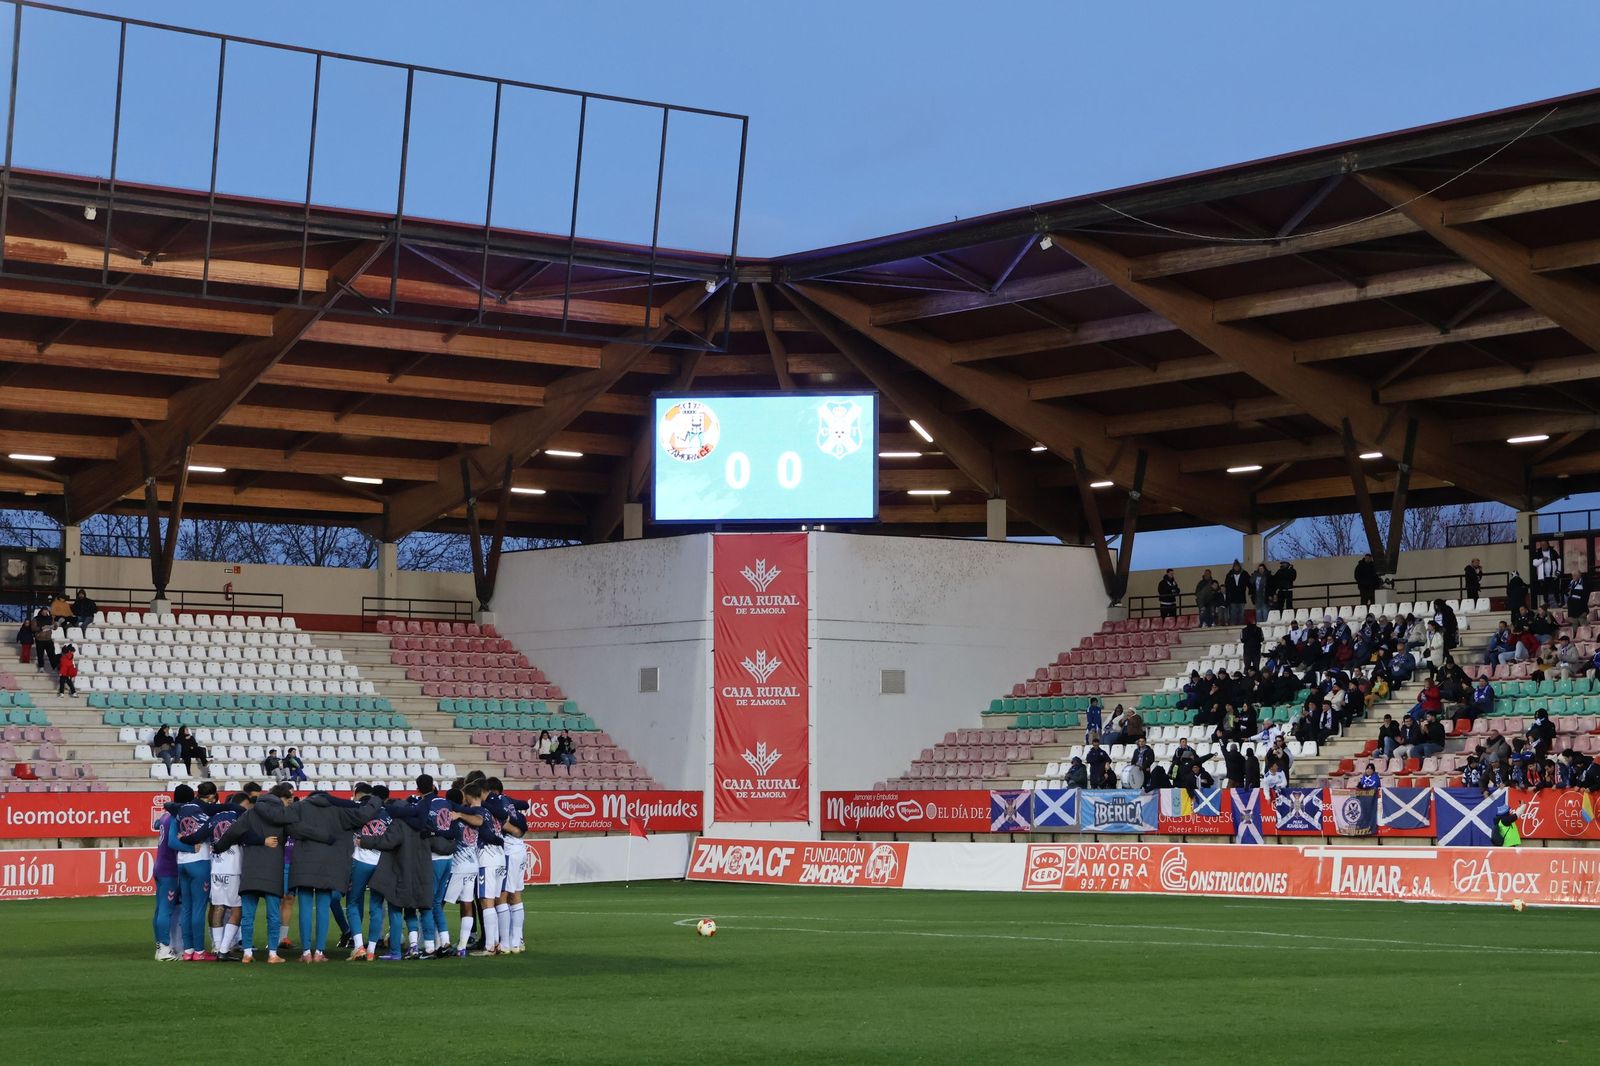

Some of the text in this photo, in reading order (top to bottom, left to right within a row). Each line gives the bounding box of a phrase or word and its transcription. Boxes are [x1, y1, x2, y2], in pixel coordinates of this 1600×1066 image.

[725, 451, 803, 489] 0 0
[722, 595, 800, 606] CAJA RURAL
[722, 686, 800, 697] CAJA RURAL
[722, 778, 800, 789] CAJA RURAL
[7, 806, 130, 825] leomotor.net
[938, 808, 950, 819] EL
[951, 804, 970, 819] DÍA
[971, 808, 984, 819] DE
[1095, 801, 1143, 825] IBÉRICA
[527, 820, 613, 829] amones y Embutidos
[1168, 825, 1219, 833] Cheese Flowers
[1564, 819, 1584, 828] TES
[693, 844, 795, 877] ZAMORA CF
[803, 844, 865, 864] FUNDACIÓN
[1035, 856, 1060, 865] ONDA
[1066, 846, 1151, 861] ONDA CERO
[2, 856, 55, 887] nión
[98, 851, 128, 884] La
[1065, 863, 1149, 877] ZAMORA
[1550, 857, 1600, 875] CLÍNI
[1035, 870, 1058, 880] CERO
[1471, 851, 1541, 901] Ápex
[107, 884, 153, 894] El Correo
[1080, 878, 1130, 890] 99.7 FM
[0, 888, 39, 896] Zamora
